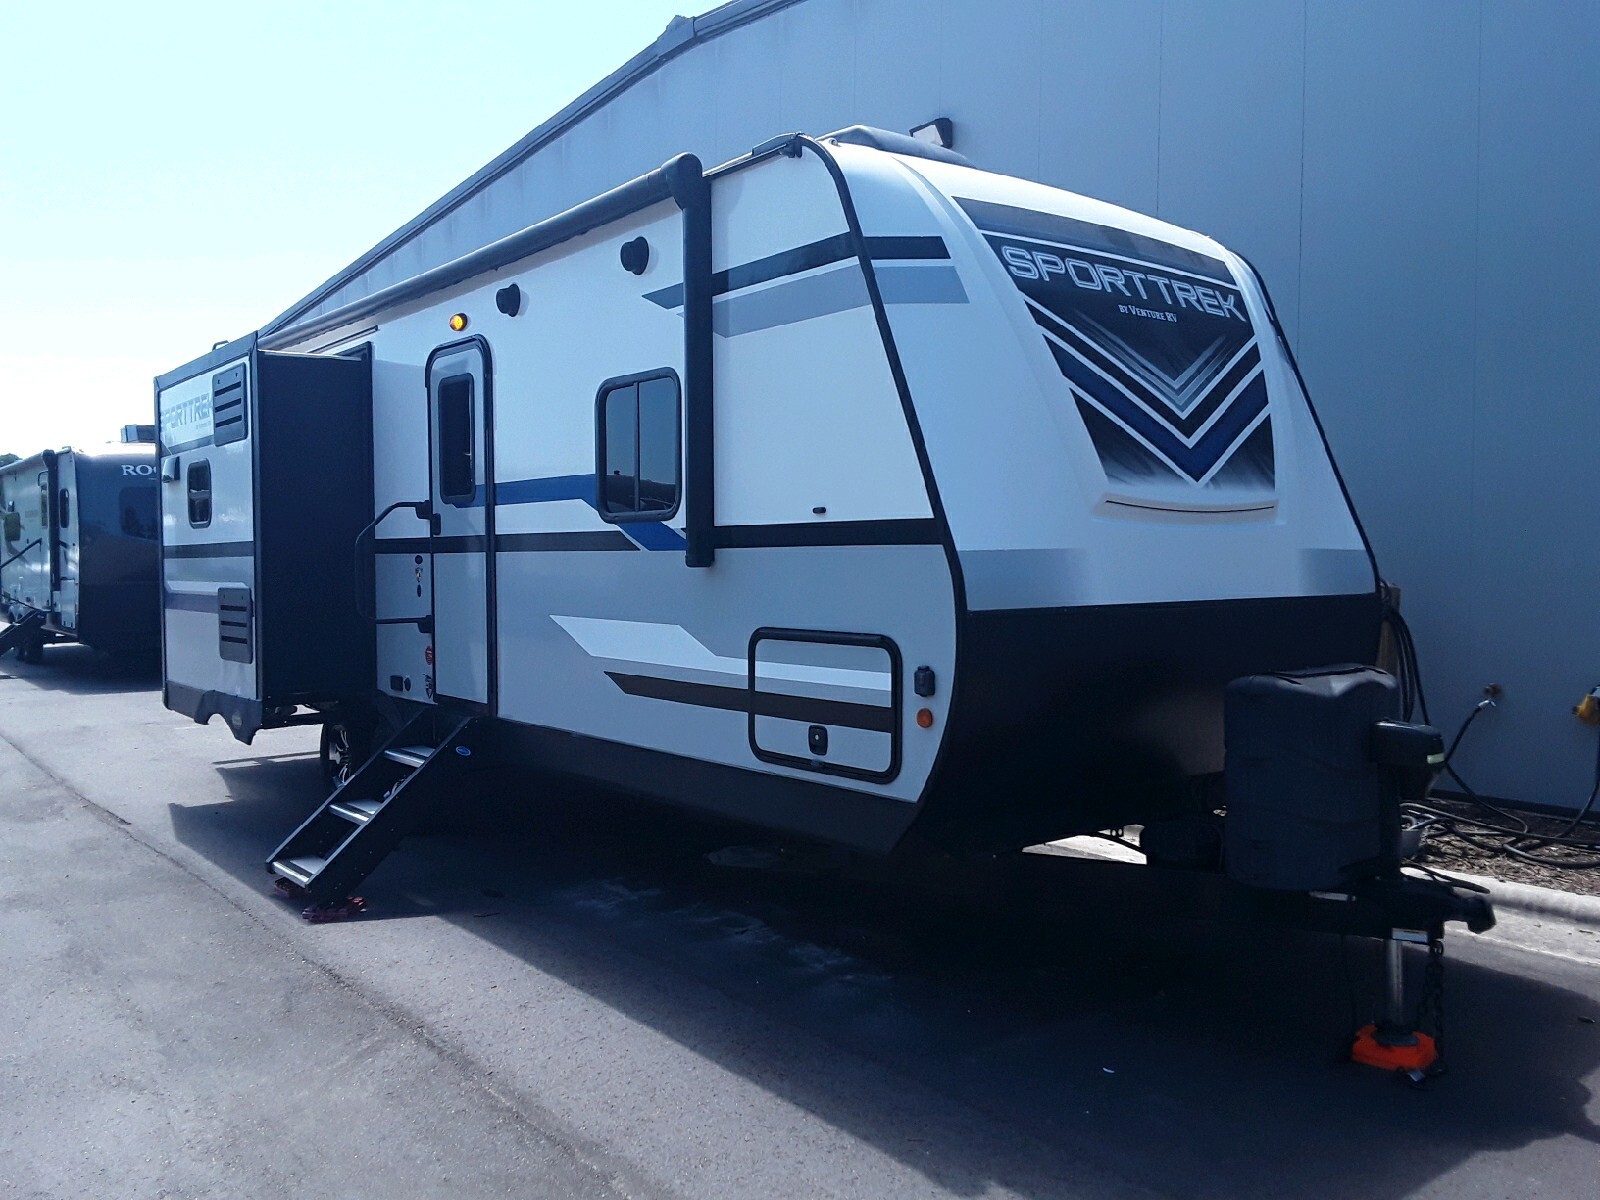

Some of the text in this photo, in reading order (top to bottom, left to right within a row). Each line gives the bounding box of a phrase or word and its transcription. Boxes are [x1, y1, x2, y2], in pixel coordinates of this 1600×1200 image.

[1002, 246, 1246, 322] SPORTTREK
[1118, 304, 1177, 323] BY VENTURE RV
